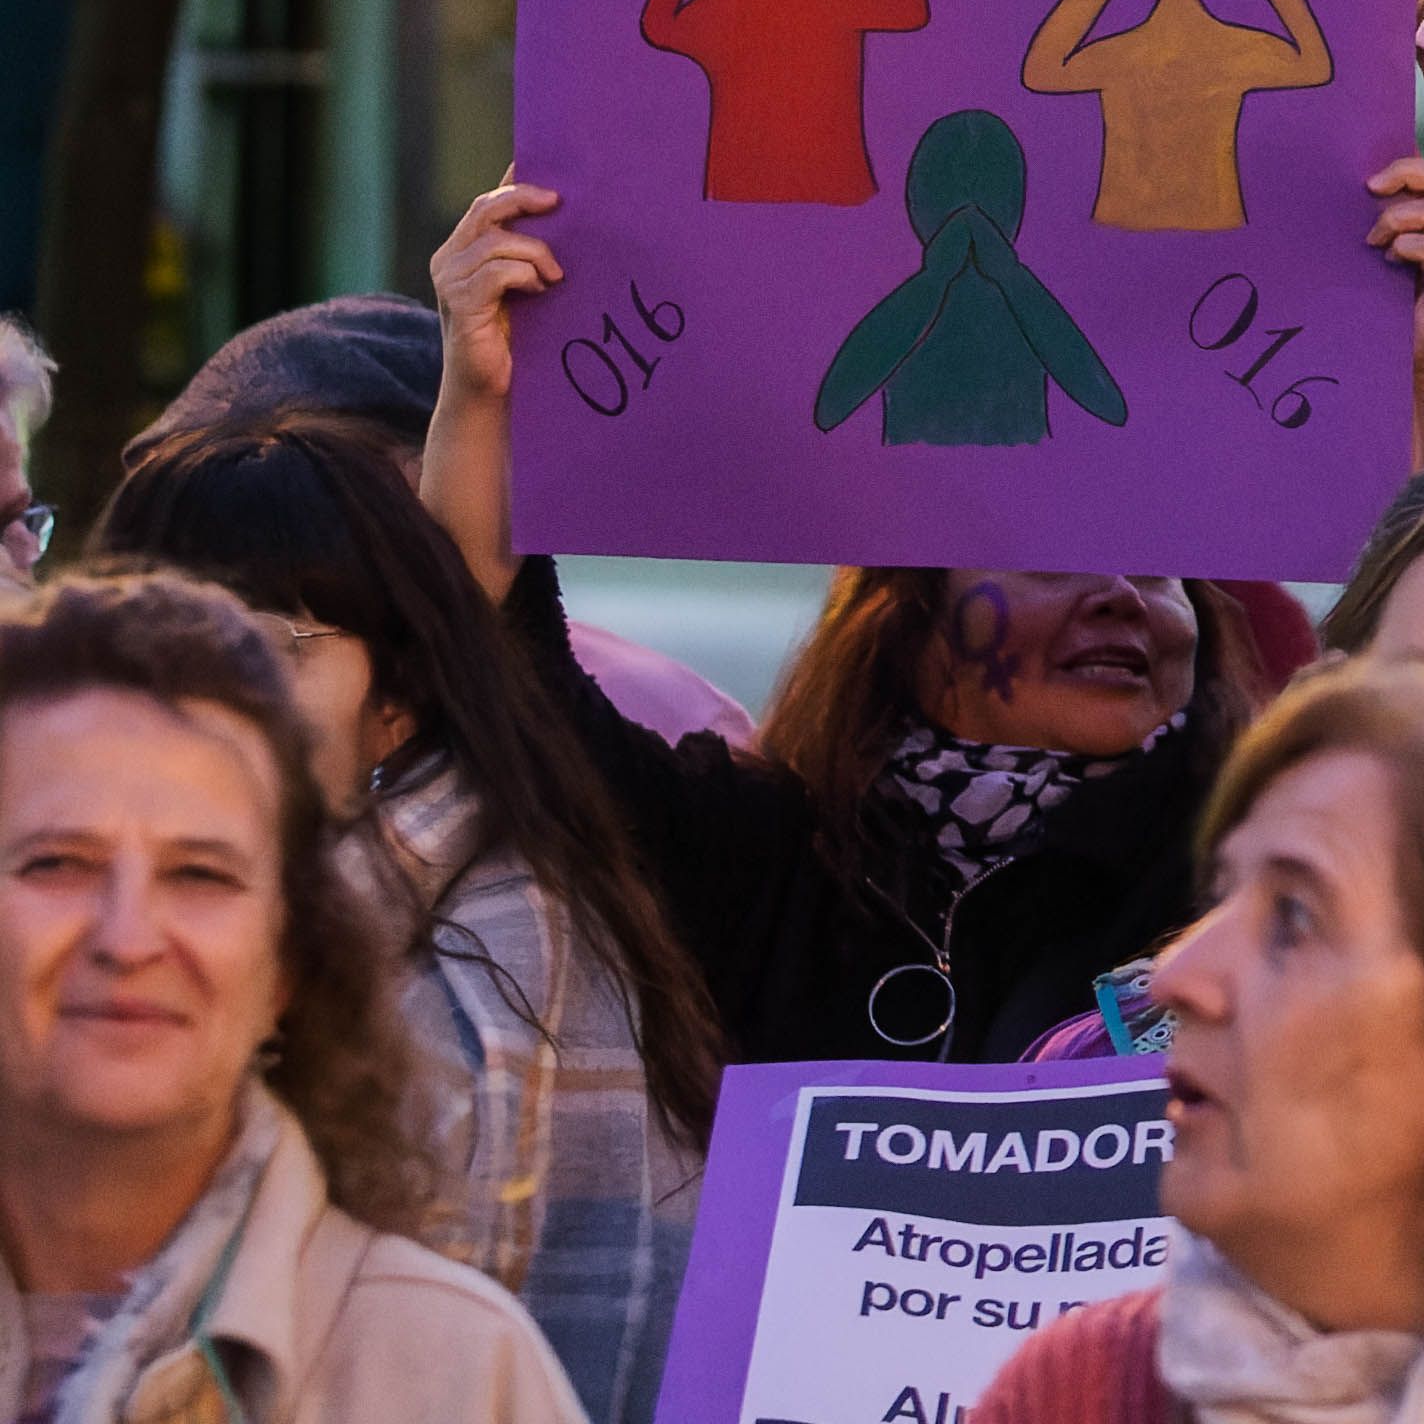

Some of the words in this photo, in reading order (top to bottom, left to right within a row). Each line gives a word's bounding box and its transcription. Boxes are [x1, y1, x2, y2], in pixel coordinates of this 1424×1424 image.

[560, 280, 686, 418] 016
[1188, 271, 1339, 430] 016
[834, 1119, 1176, 1174] TOMADOR
[852, 1217, 1169, 1279] Atropellada
[860, 1280, 961, 1320] por
[972, 1298, 1042, 1330] su
